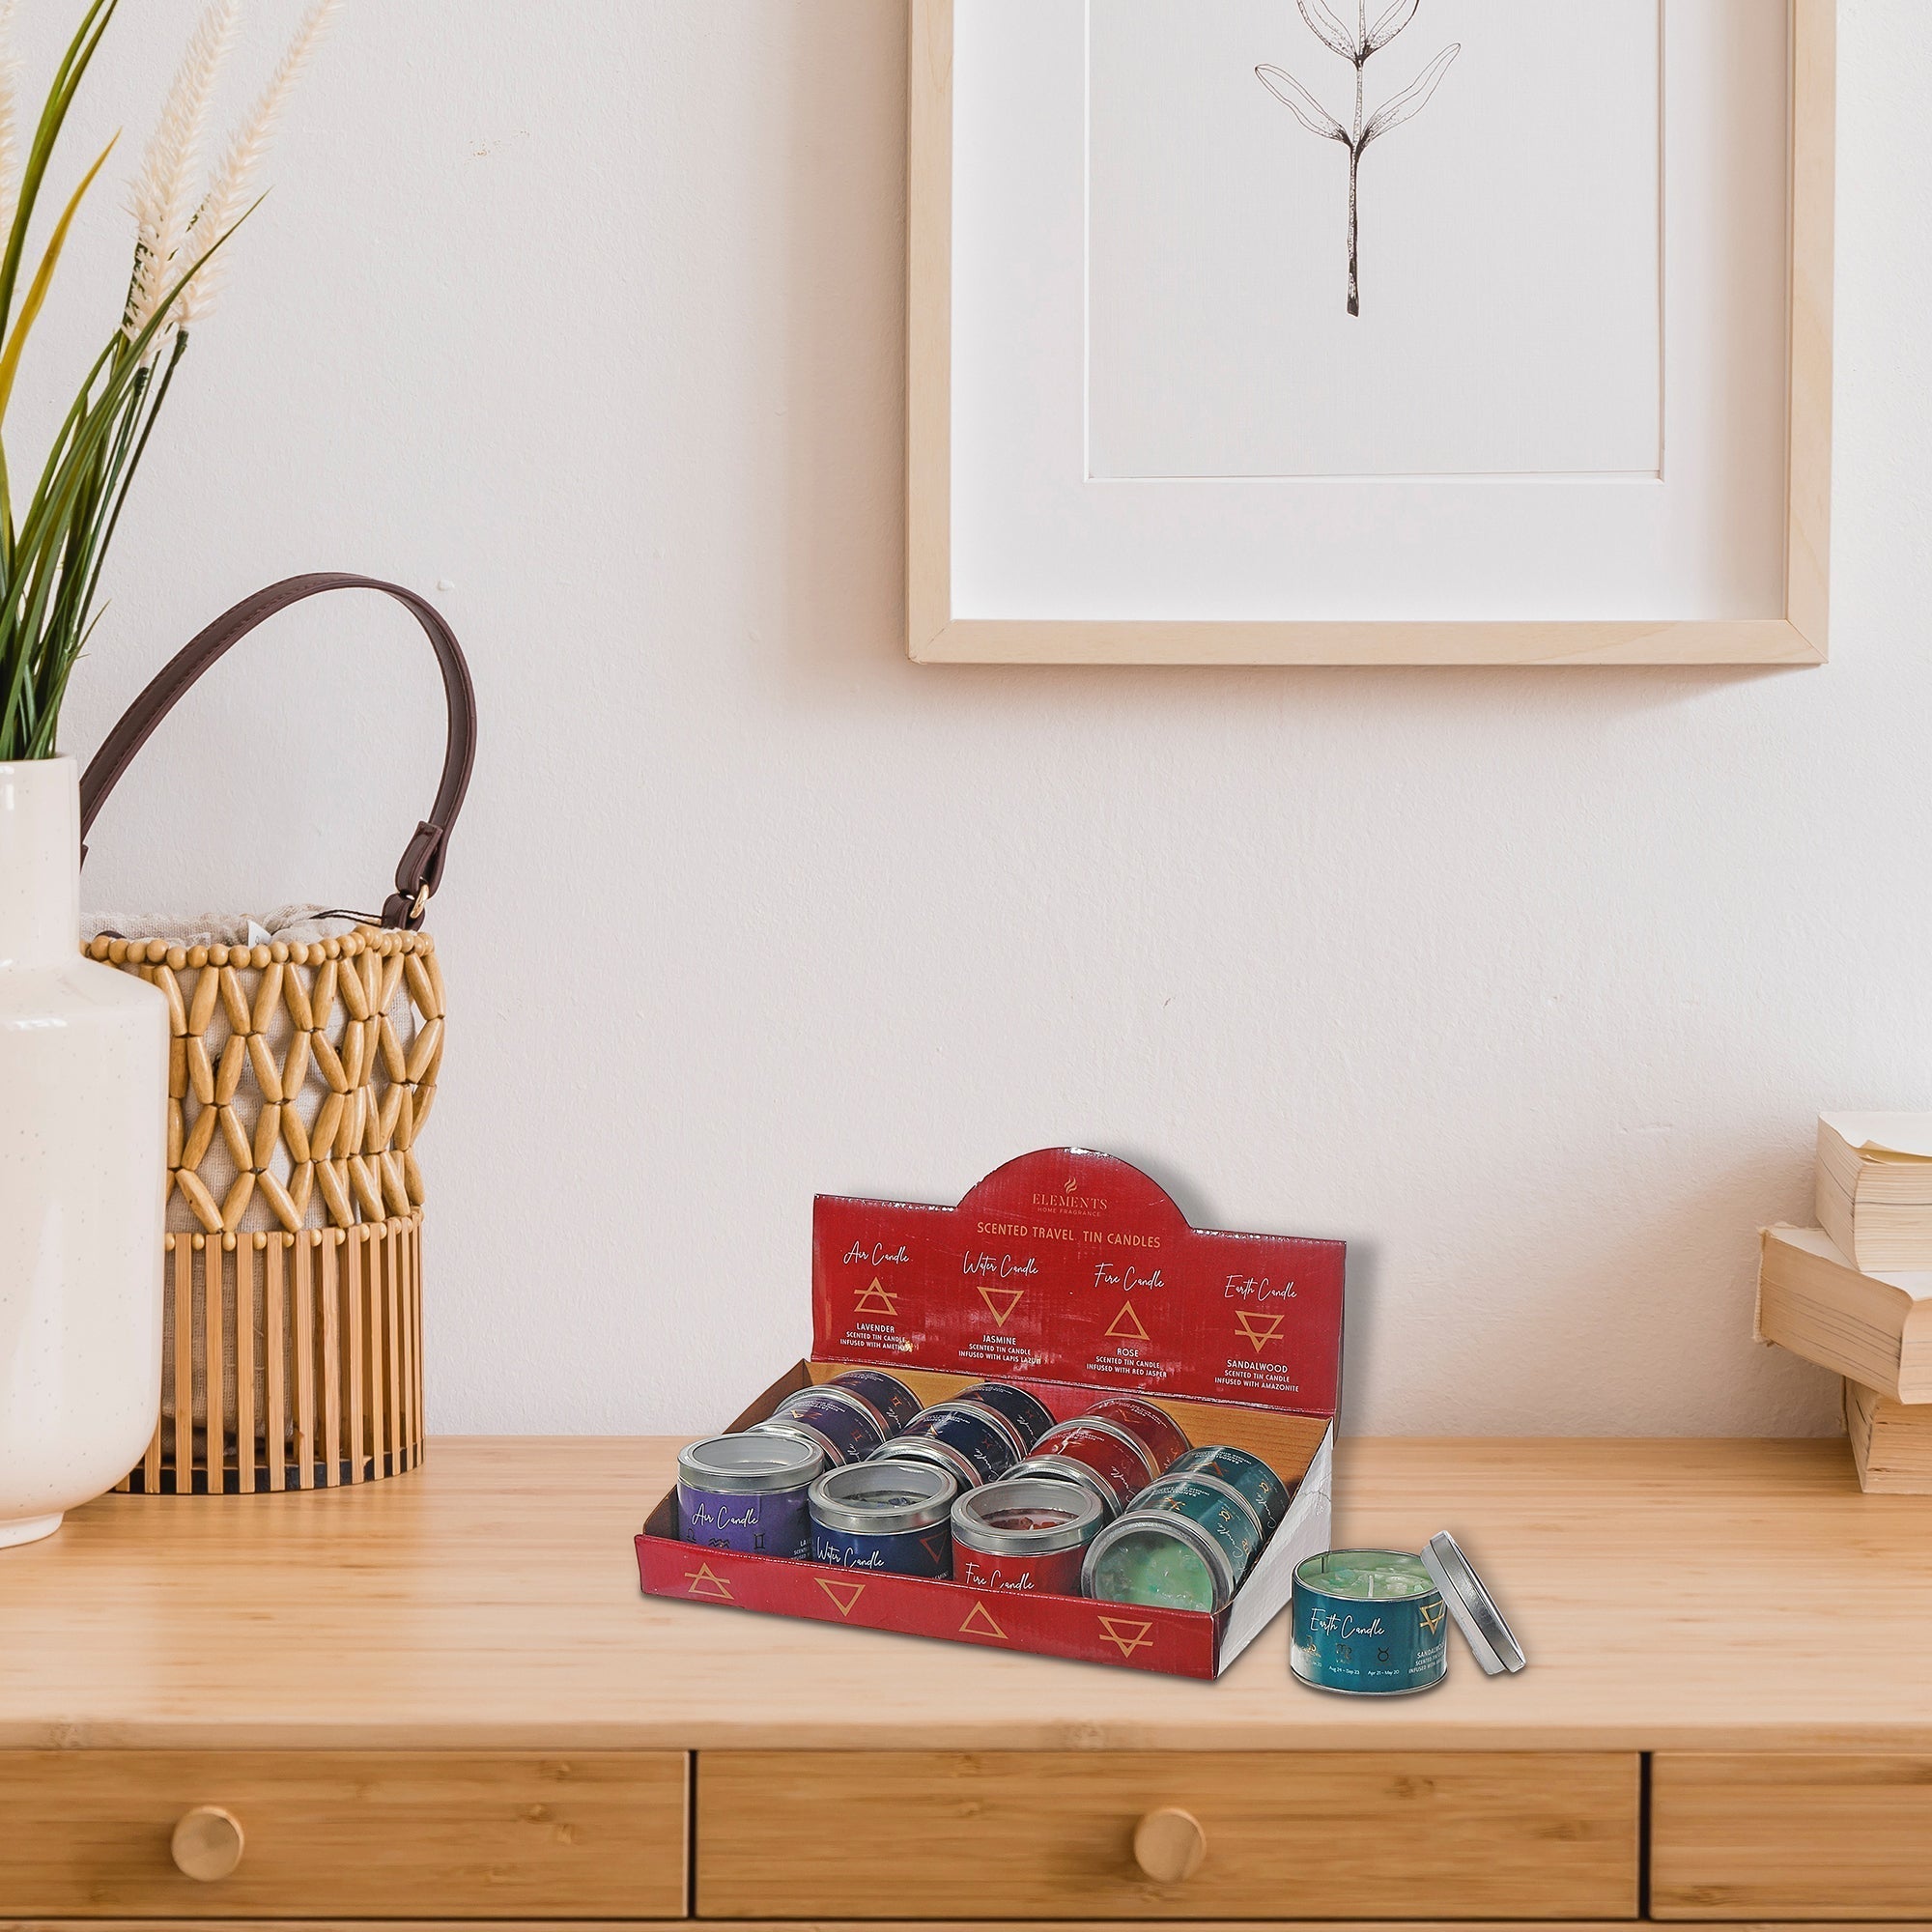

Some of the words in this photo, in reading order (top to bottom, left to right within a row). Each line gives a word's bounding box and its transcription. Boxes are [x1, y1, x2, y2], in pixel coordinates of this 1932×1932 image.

[1033, 1193, 1108, 1210] ELEMENTS
[1060, 1209, 1100, 1217] FRAGRANCE
[977, 1222, 1028, 1237] SCENTED
[1032, 1226, 1074, 1241] TRAVEL
[1083, 1231, 1102, 1243] TIN
[1107, 1233, 1161, 1248] CANDLES
[843, 1241, 869, 1264] Air
[872, 1242, 909, 1266] Candle
[963, 1250, 997, 1276] Water
[1000, 1254, 1039, 1278] Candle
[1094, 1263, 1120, 1288] Fire
[1123, 1266, 1165, 1292] Candle
[1224, 1275, 1258, 1300] Earth
[1258, 1278, 1298, 1302] Candle
[856, 1322, 895, 1333] LAVENDER
[847, 1331, 871, 1339] SCENTED
[983, 1335, 1017, 1345] JASMINE
[959, 1350, 984, 1359] INFUSED
[969, 1343, 994, 1352] SCENTED
[1117, 1348, 1139, 1357] ROSE
[1096, 1356, 1122, 1364] SCENTED
[1227, 1359, 1288, 1373] SANDALWOOD
[1086, 1364, 1113, 1372] INFUSED
[1224, 1369, 1251, 1378] SCENTED
[1265, 1374, 1290, 1383] CANDLE
[1215, 1377, 1242, 1386] INFUSED
[1261, 1382, 1299, 1392] AMAZONITE
[691, 1503, 714, 1526] Air
[717, 1506, 759, 1530] Candle
[817, 1536, 841, 1565] Water
[844, 1547, 884, 1569] Candle
[966, 1562, 987, 1584] Fire
[991, 1569, 1035, 1590] Candle
[1310, 1607, 1341, 1636] Earth
[1341, 1615, 1385, 1639] Candle
